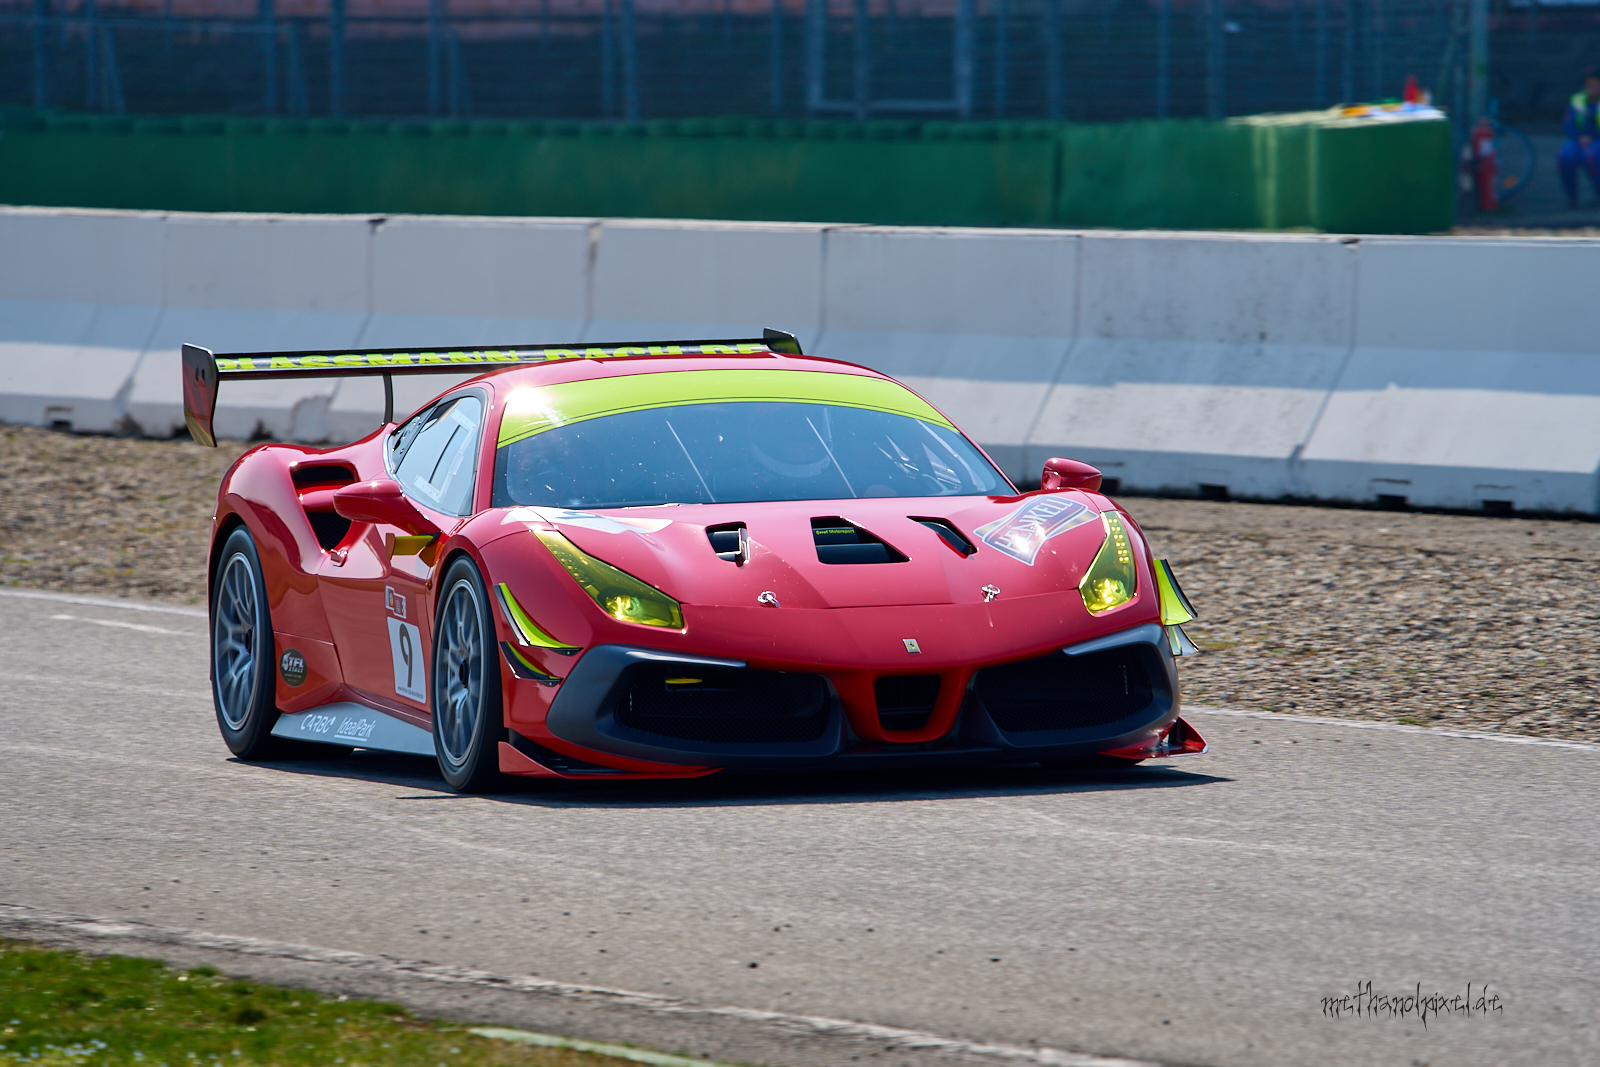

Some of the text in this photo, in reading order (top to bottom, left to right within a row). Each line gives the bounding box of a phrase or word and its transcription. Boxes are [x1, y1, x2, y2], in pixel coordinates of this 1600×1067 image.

[994, 498, 1074, 555] HENKELL
[288, 656, 304, 668] TFL
[399, 623, 413, 688] 9
[336, 716, 376, 738] IdealPark
